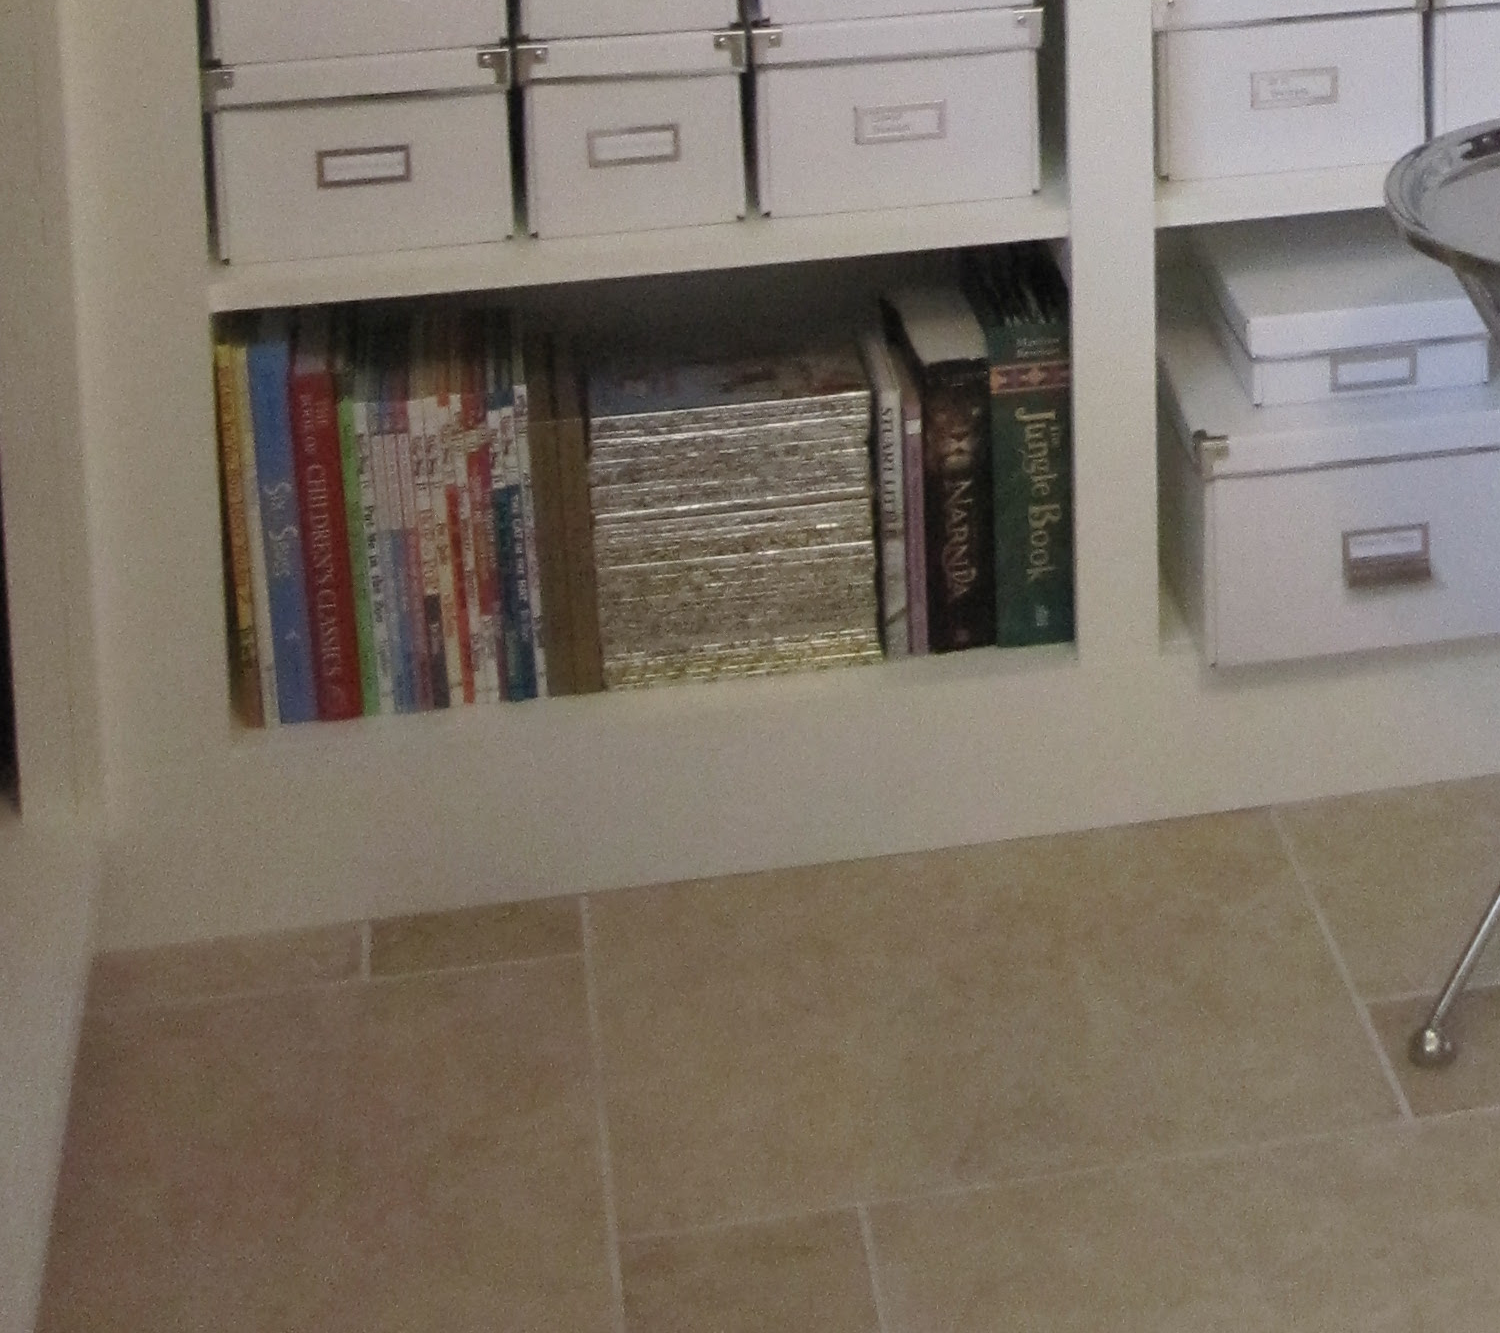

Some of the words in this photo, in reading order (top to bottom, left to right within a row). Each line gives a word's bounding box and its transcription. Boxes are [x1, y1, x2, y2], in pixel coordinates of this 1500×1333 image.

[880, 406, 894, 472] STUART
[1014, 406, 1059, 496] Jungle
[305, 462, 336, 585] CHILDREN'S
[512, 518, 524, 539] CAT
[1025, 502, 1062, 586] Book
[516, 579, 528, 601] HAT
[317, 589, 341, 681] CLASSICS
